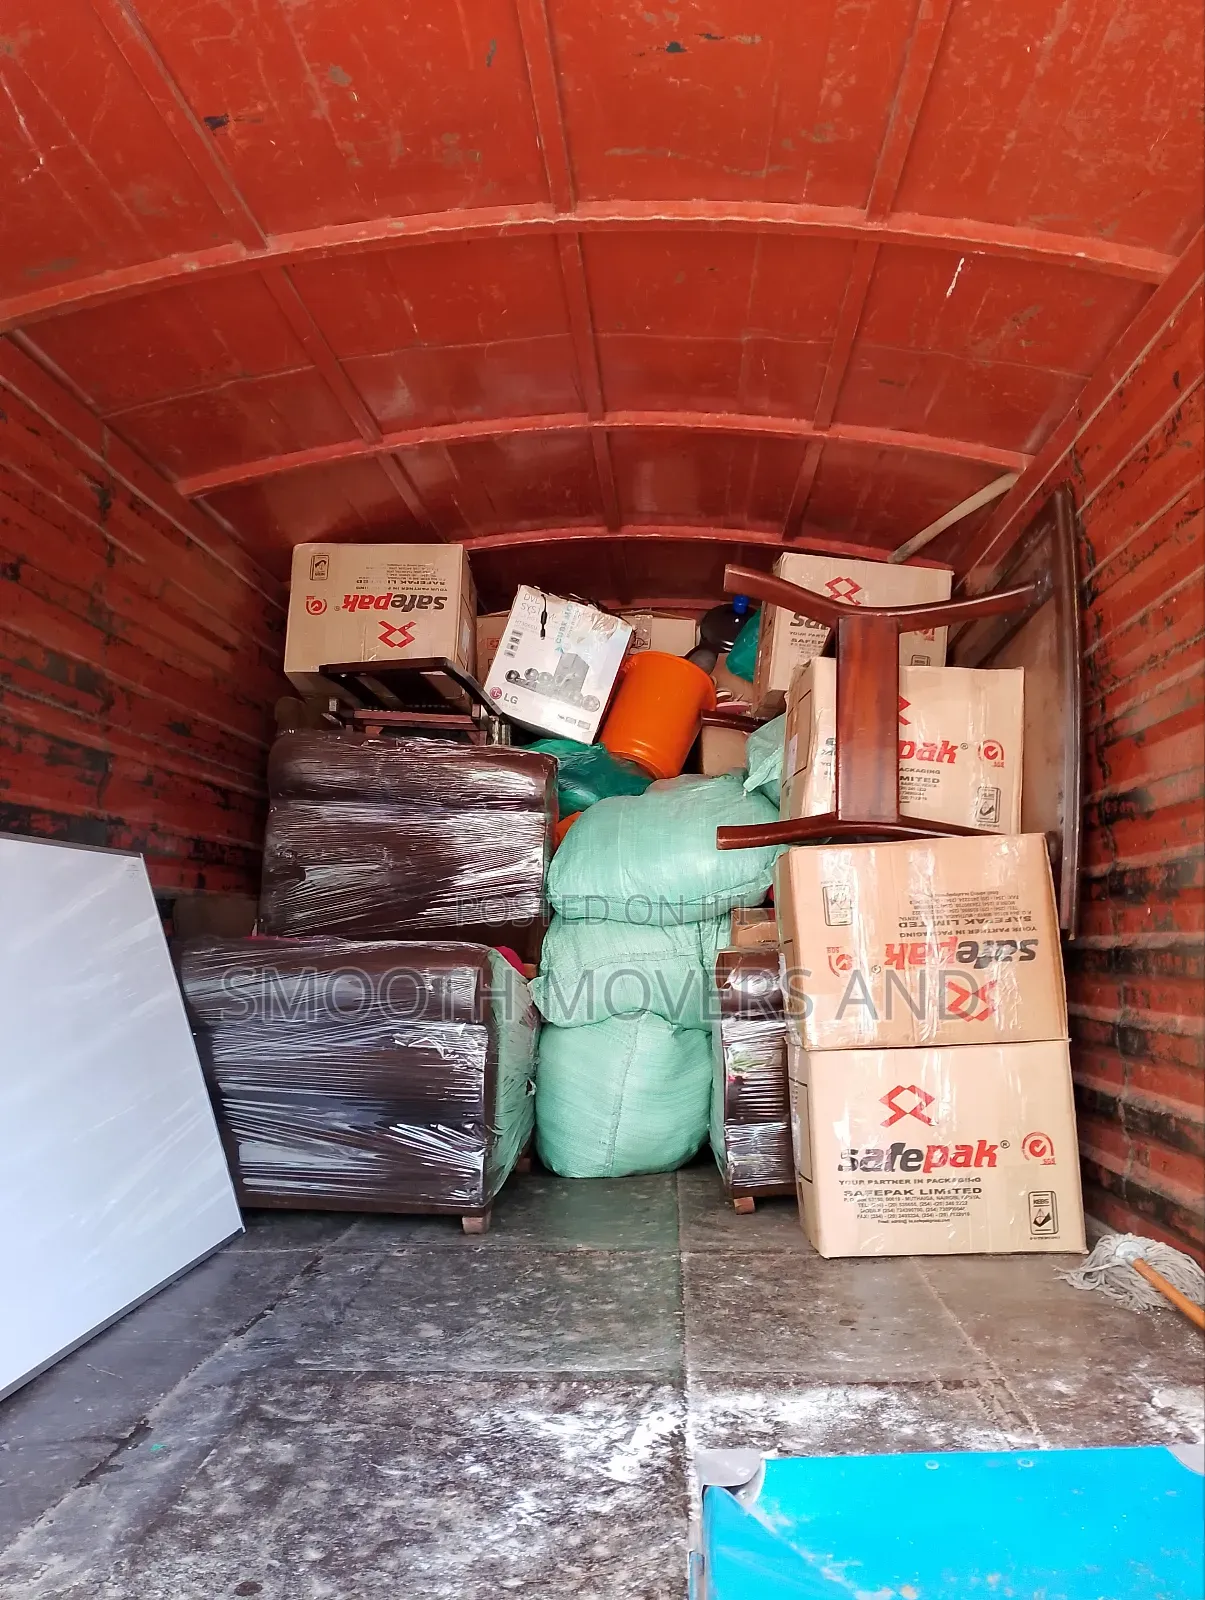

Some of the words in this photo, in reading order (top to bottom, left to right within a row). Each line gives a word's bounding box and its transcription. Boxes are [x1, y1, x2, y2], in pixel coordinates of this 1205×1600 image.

[342, 592, 448, 612] safepak
[503, 692, 518, 706] LG
[899, 776, 940, 784] MITED
[898, 919, 960, 928] LIMTED
[882, 936, 1040, 970] safepak
[837, 1139, 998, 1174] safepak
[843, 1188, 914, 1197] SAFEPAK
[919, 1187, 982, 1195] LIMITED
